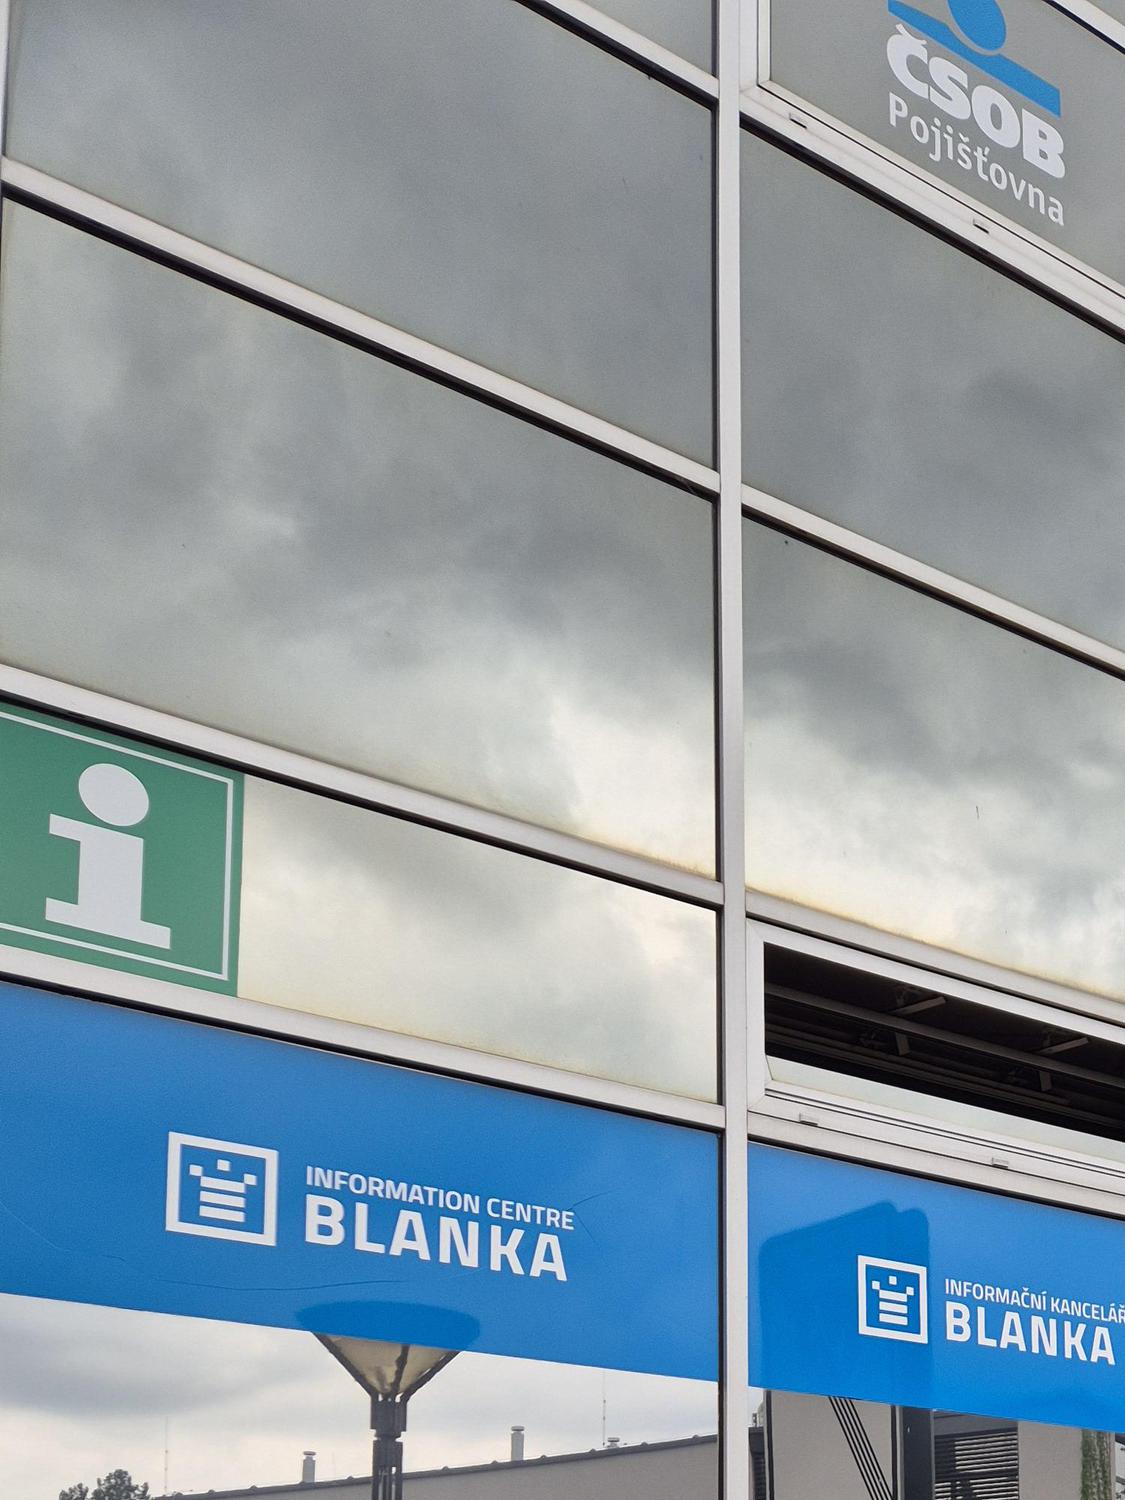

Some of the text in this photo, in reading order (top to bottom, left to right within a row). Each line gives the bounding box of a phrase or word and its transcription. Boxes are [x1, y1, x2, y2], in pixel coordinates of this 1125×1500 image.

[886, 23, 1066, 180] ČSOB
[888, 91, 1065, 227] Pojišťovna
[305, 1165, 575, 1231] INFORMATION CENTRE
[305, 1194, 568, 1282] BLANKA
[944, 1278, 1047, 1311] INFORMAČNÍ
[945, 1301, 1116, 1366] BLANKA
